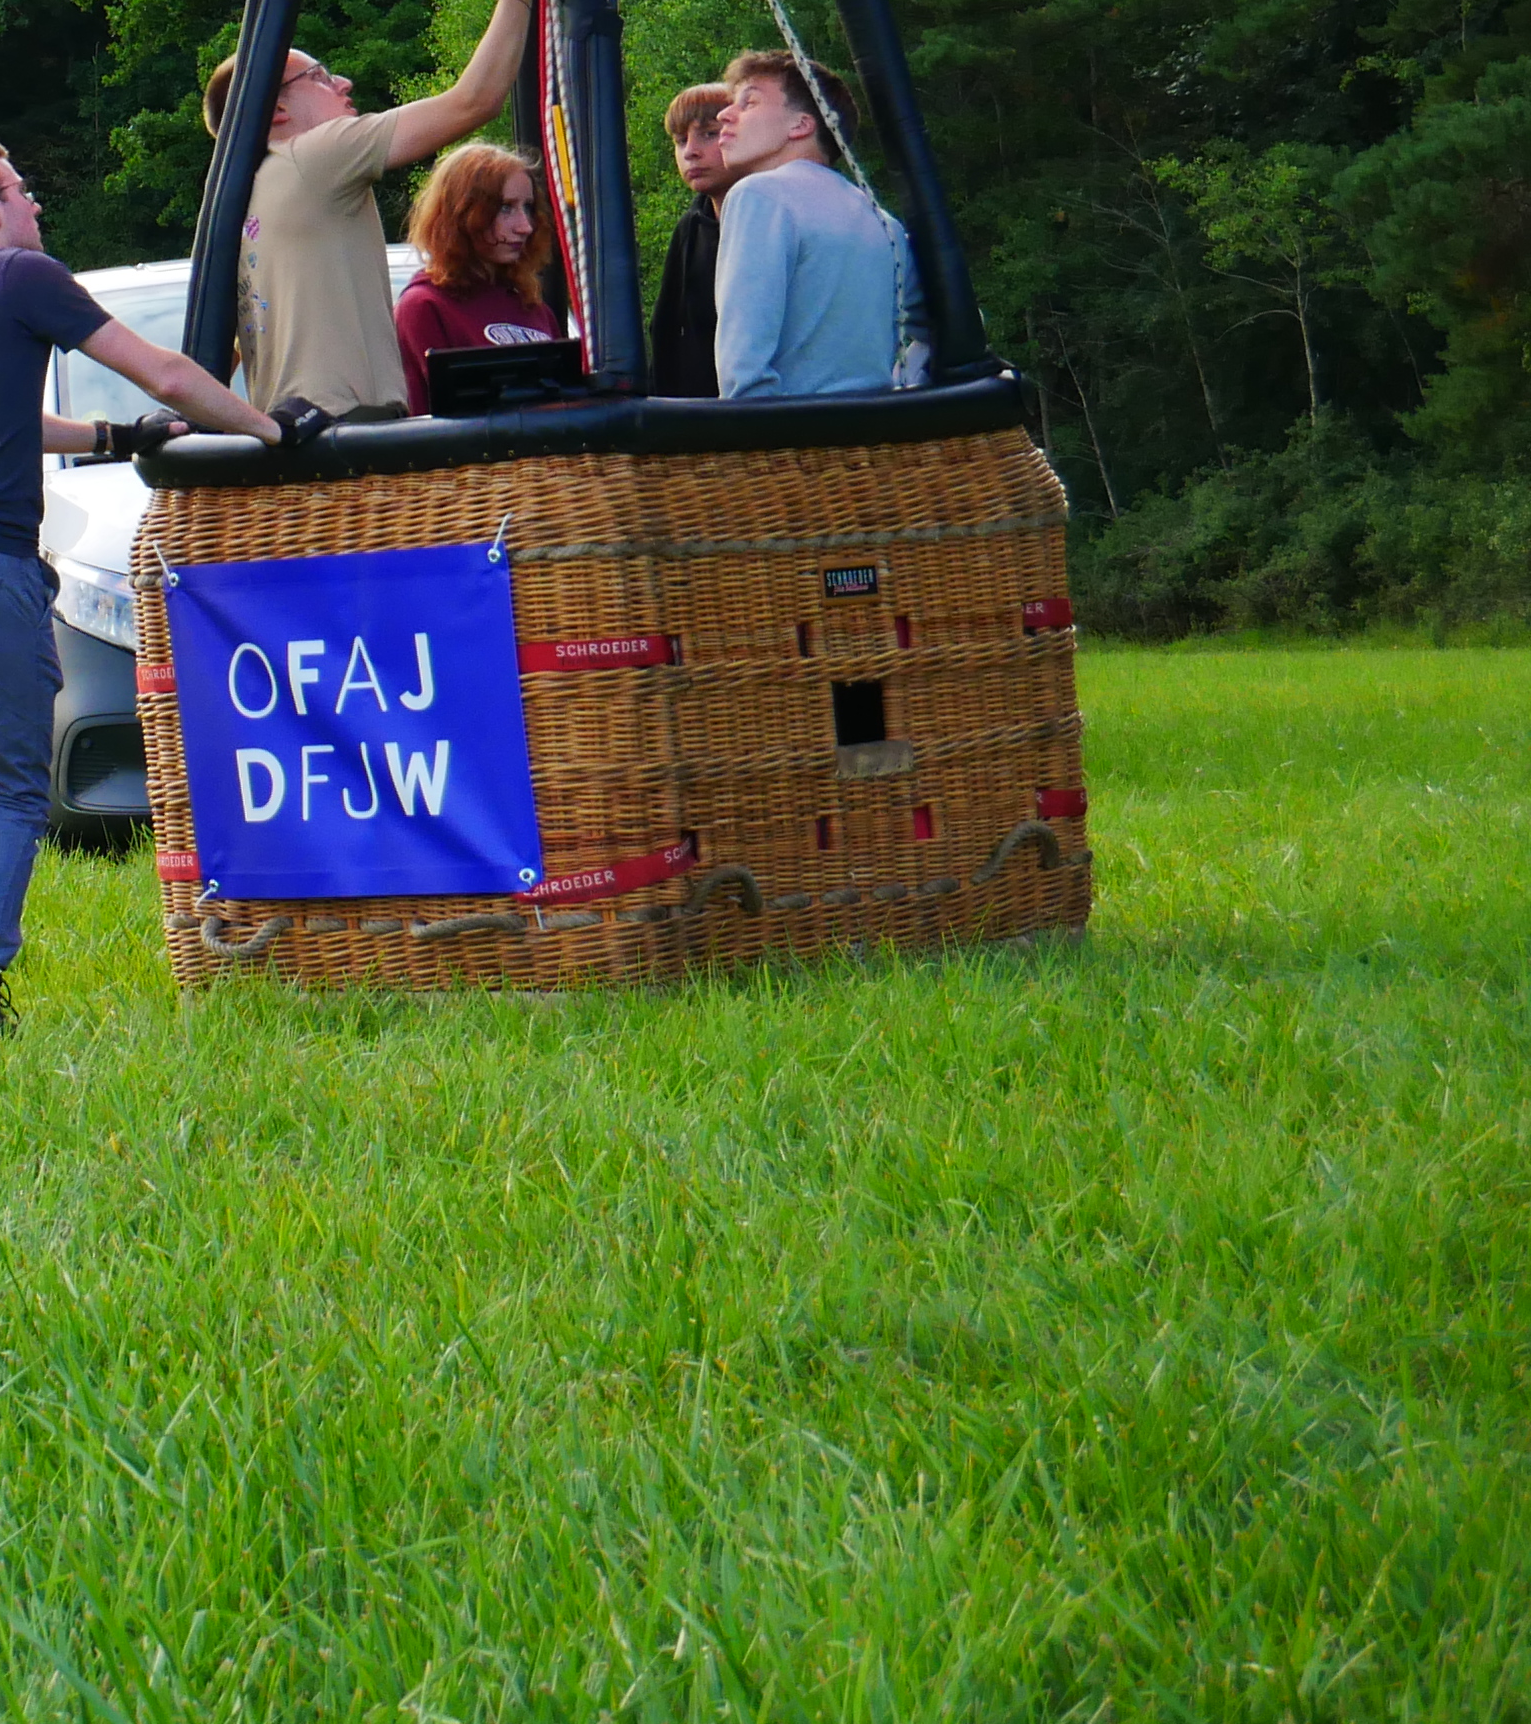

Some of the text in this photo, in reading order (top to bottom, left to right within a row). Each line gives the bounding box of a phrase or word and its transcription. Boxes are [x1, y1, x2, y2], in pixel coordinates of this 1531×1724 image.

[228, 632, 434, 719] OFAJ
[555, 639, 649, 657] SCHROEDER
[235, 739, 450, 823] DFJW
